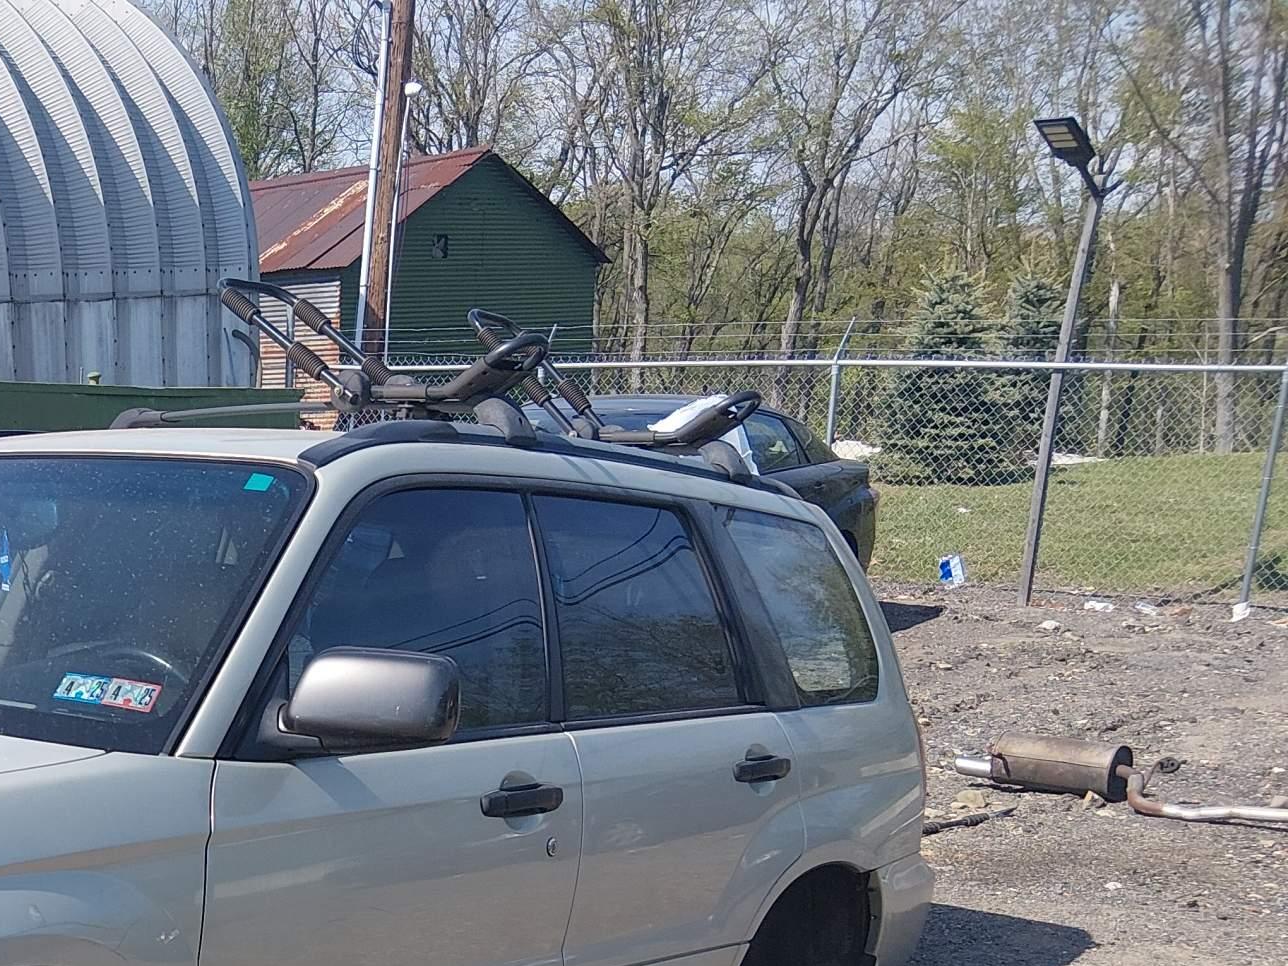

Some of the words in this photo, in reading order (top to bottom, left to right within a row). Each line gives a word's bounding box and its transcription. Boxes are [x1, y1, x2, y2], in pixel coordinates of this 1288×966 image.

[64, 680, 75, 696] 4
[89, 680, 108, 699] 25
[112, 685, 123, 700] 4
[138, 687, 157, 706] 25
